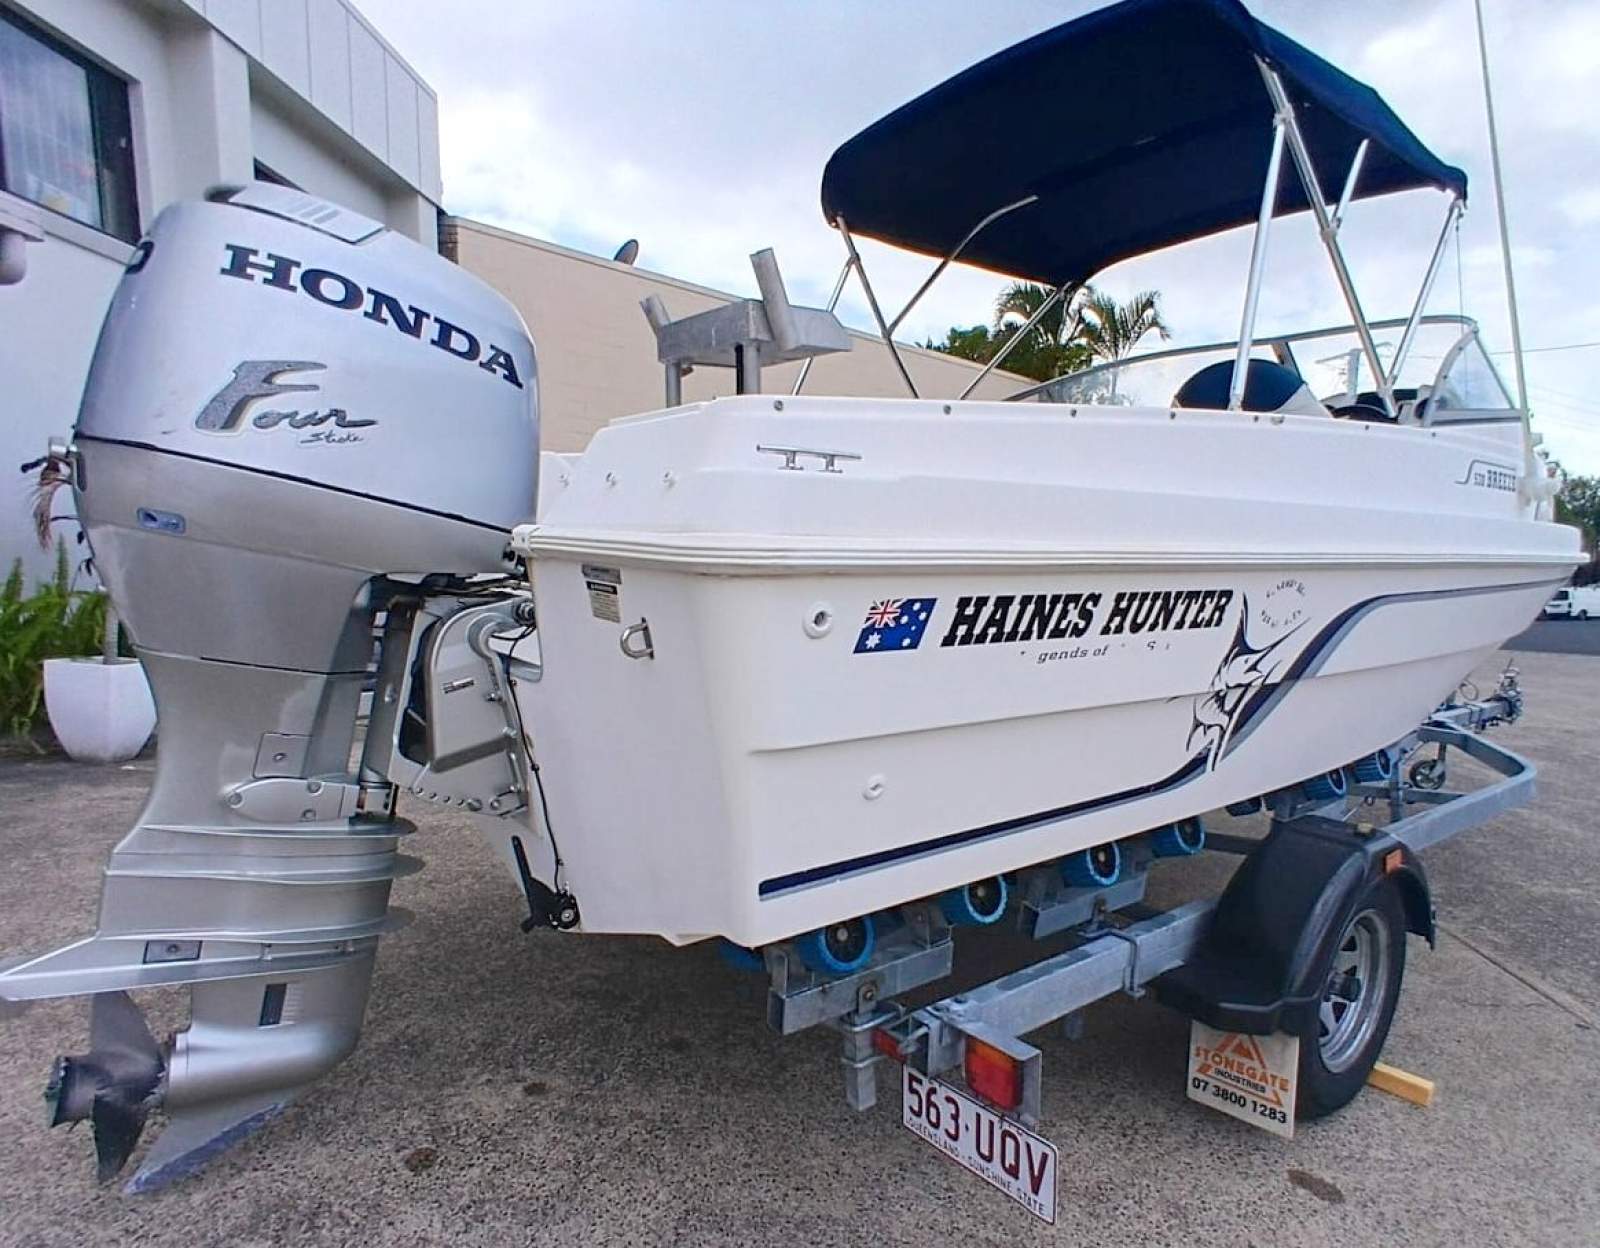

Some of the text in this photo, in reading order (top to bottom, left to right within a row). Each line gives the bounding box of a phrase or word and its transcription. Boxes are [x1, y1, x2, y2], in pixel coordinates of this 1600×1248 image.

[220, 244, 524, 390] HONDA
[195, 360, 378, 431] Four
[940, 589, 1234, 647] HAINES HUNTER
[1093, 645, 1109, 657] of
[1195, 1046, 1290, 1092] STONEGATE
[1214, 1067, 1267, 1093] INDUSTRIES
[1191, 1077, 1288, 1124] 07 3800 1283
[1018, 1187, 1045, 1216] STATE
